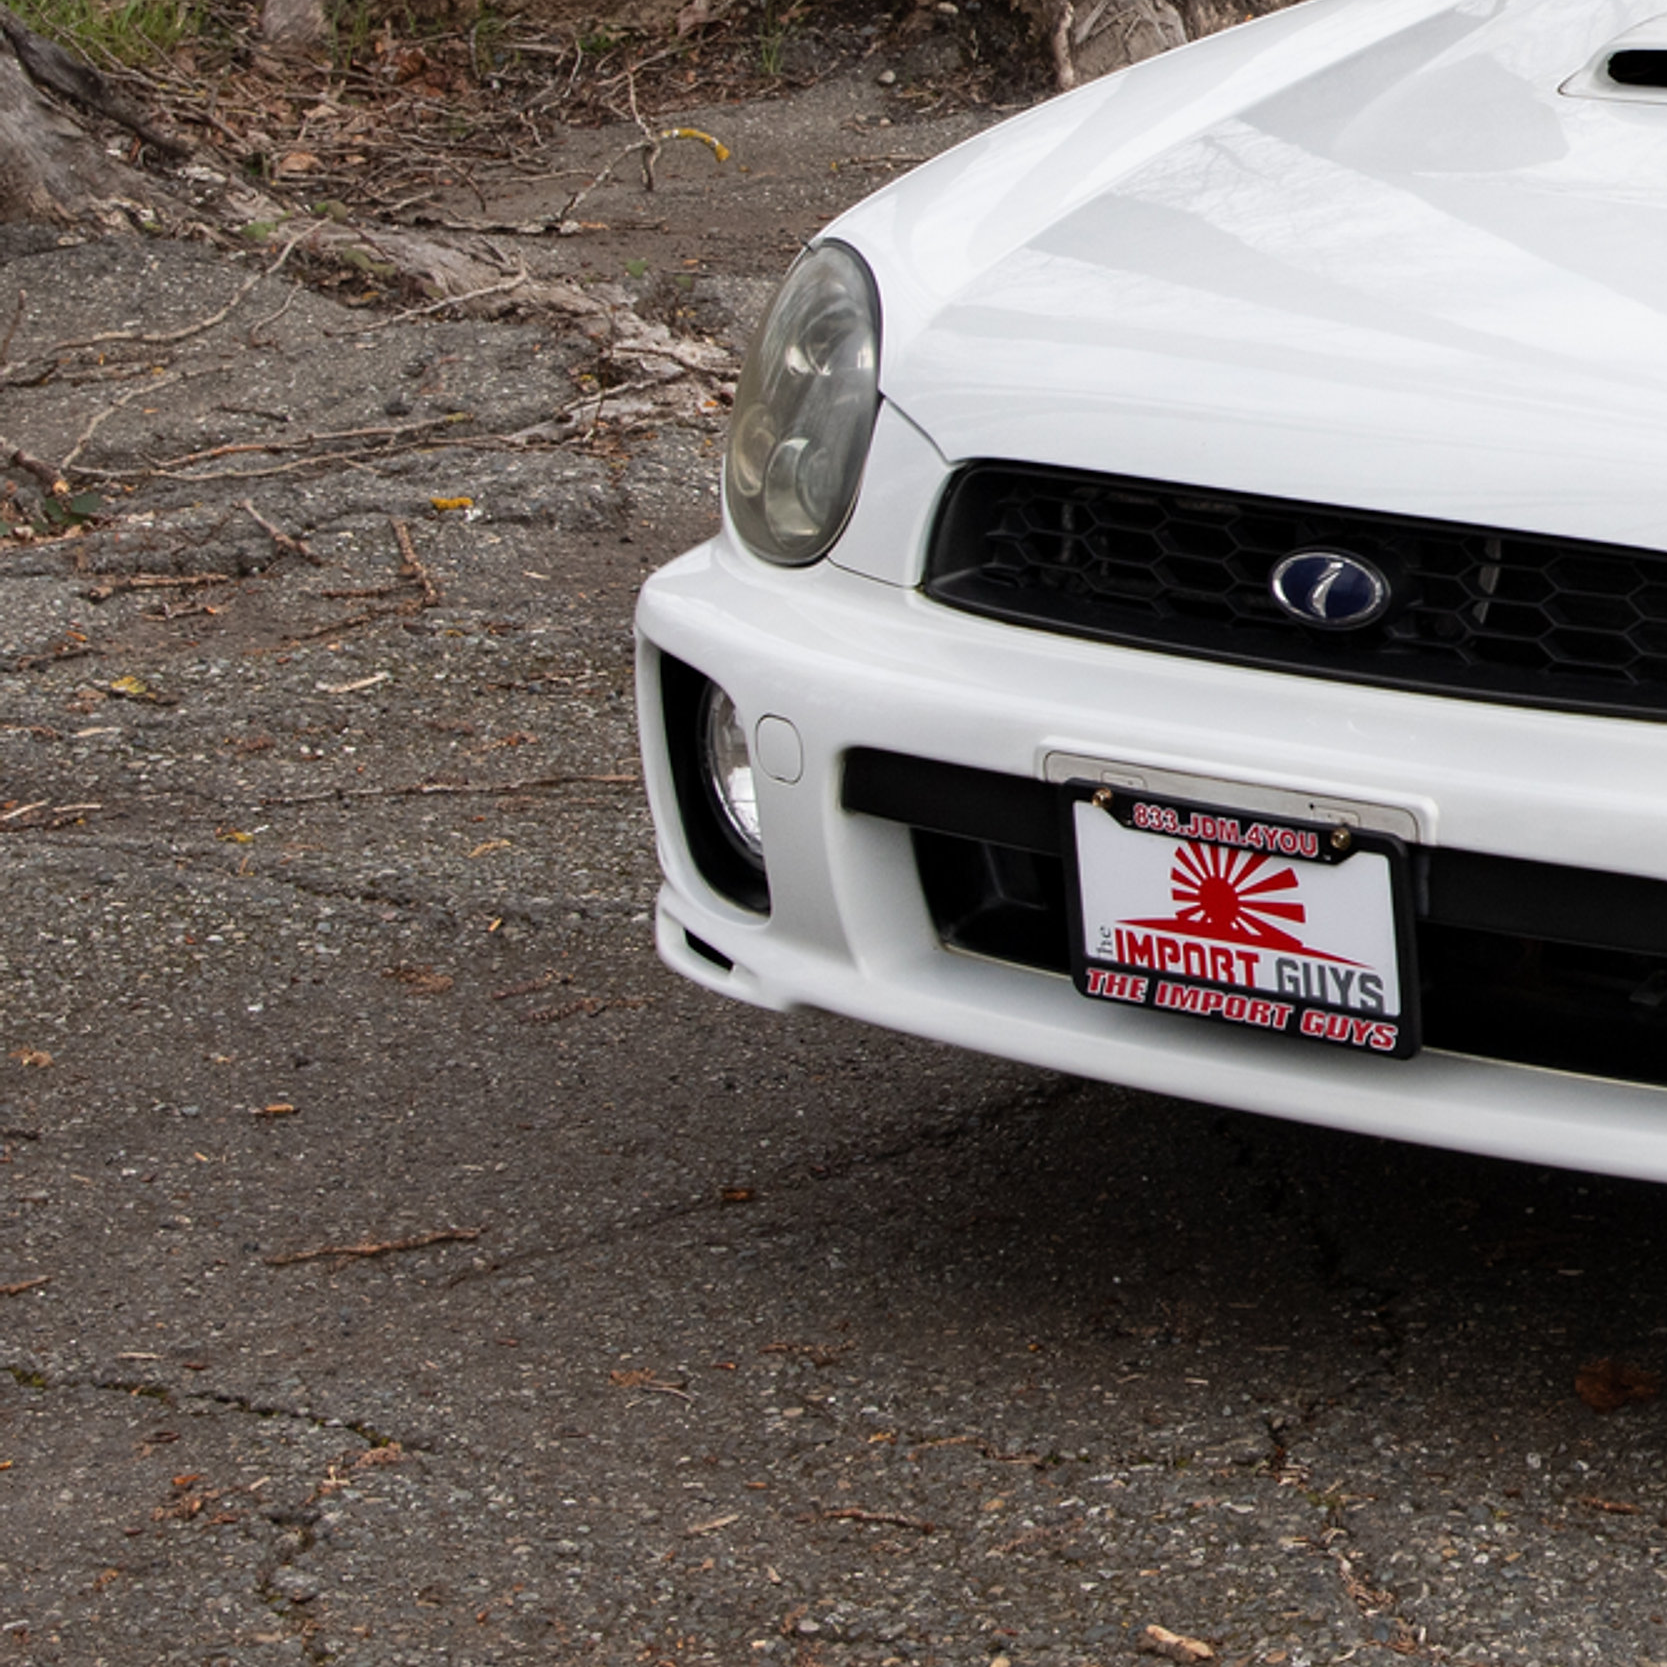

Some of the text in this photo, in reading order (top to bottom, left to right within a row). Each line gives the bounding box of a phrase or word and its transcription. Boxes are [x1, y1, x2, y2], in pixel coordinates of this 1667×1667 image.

[1133, 803, 1318, 857] 833.JDM.4YOU
[1086, 967, 1399, 1051] THE IMPORT GUYS
[1115, 928, 1385, 1014] IMPORT GUYS
